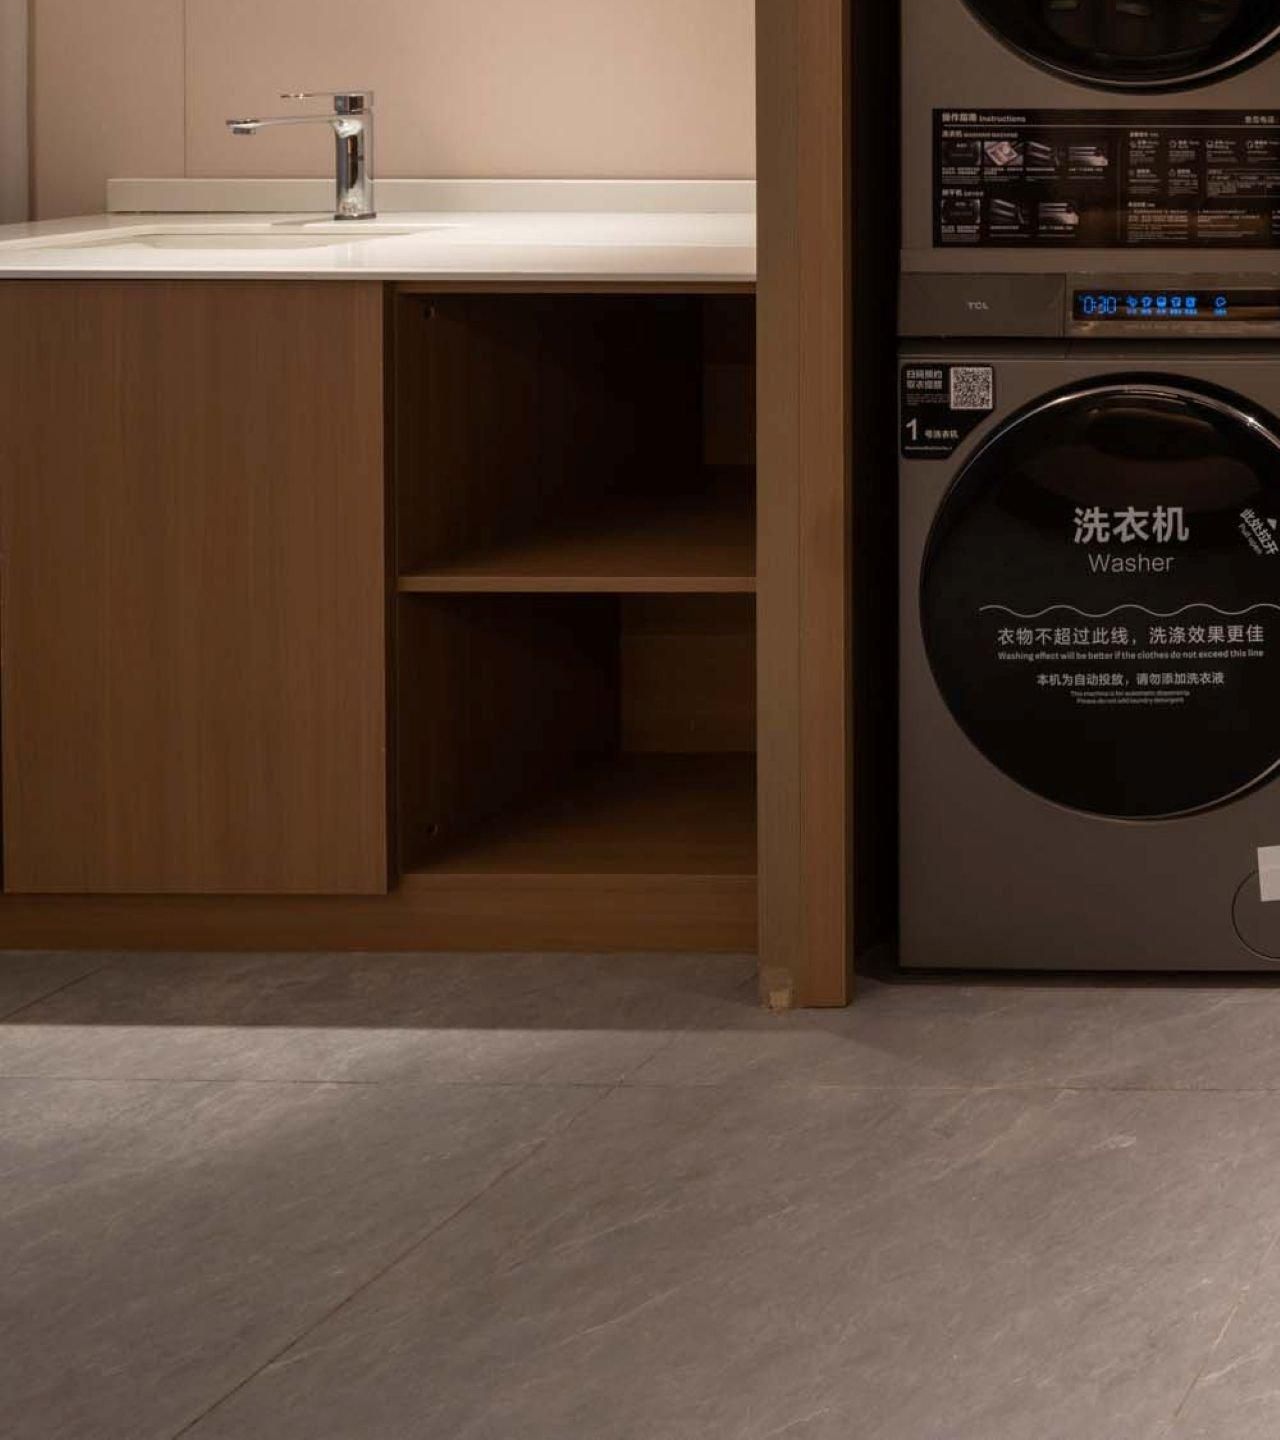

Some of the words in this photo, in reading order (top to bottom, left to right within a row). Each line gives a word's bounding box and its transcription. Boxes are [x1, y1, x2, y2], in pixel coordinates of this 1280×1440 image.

[967, 301, 989, 310] TCL
[906, 418, 918, 440] 1
[1074, 506, 1189, 543] 洗衣机
[1088, 554, 1174, 572] Washer
[998, 625, 1264, 645] 衣物不超过此线，洗涤效果更佳
